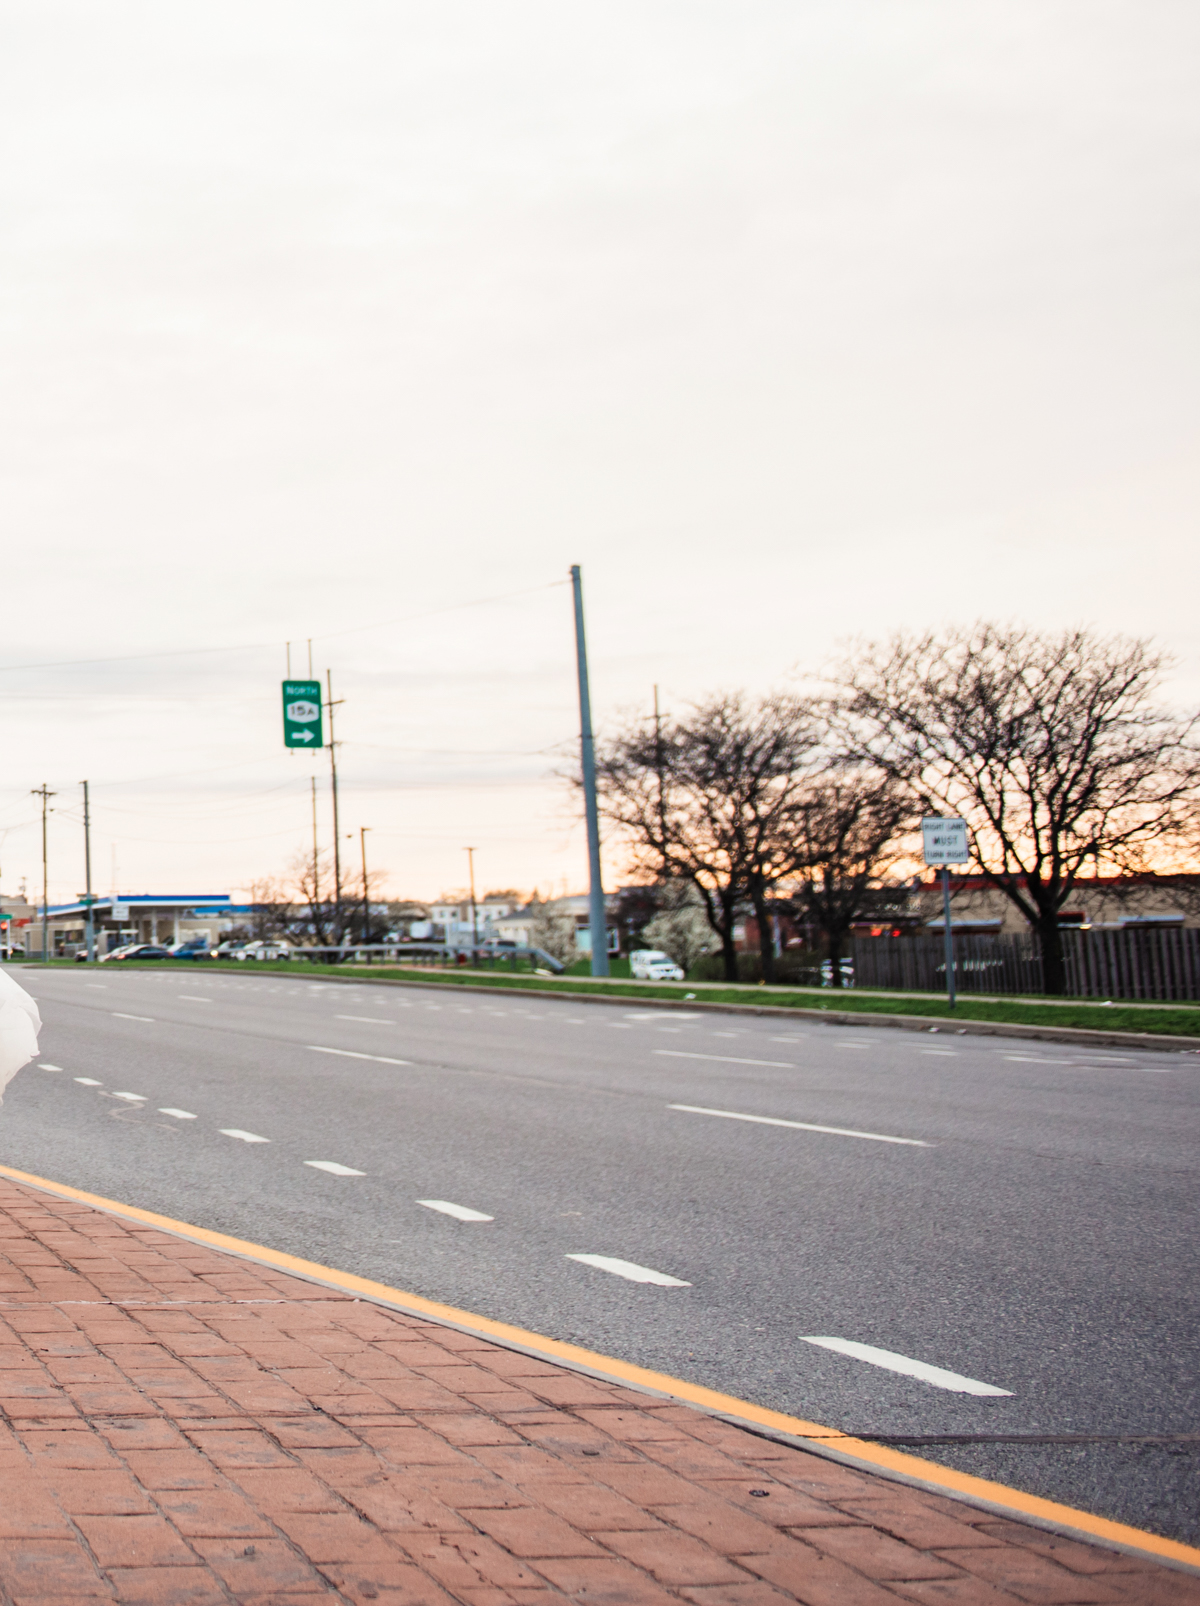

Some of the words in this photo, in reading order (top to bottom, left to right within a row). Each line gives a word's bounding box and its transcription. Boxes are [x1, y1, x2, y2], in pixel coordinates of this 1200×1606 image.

[286, 685, 318, 696] NORTH
[290, 705, 315, 716] 15A
[925, 822, 945, 831] RIGHT
[947, 822, 964, 831] LANE
[933, 835, 958, 846] MUST
[927, 850, 944, 859] TURN
[946, 850, 967, 859] RIGHT
